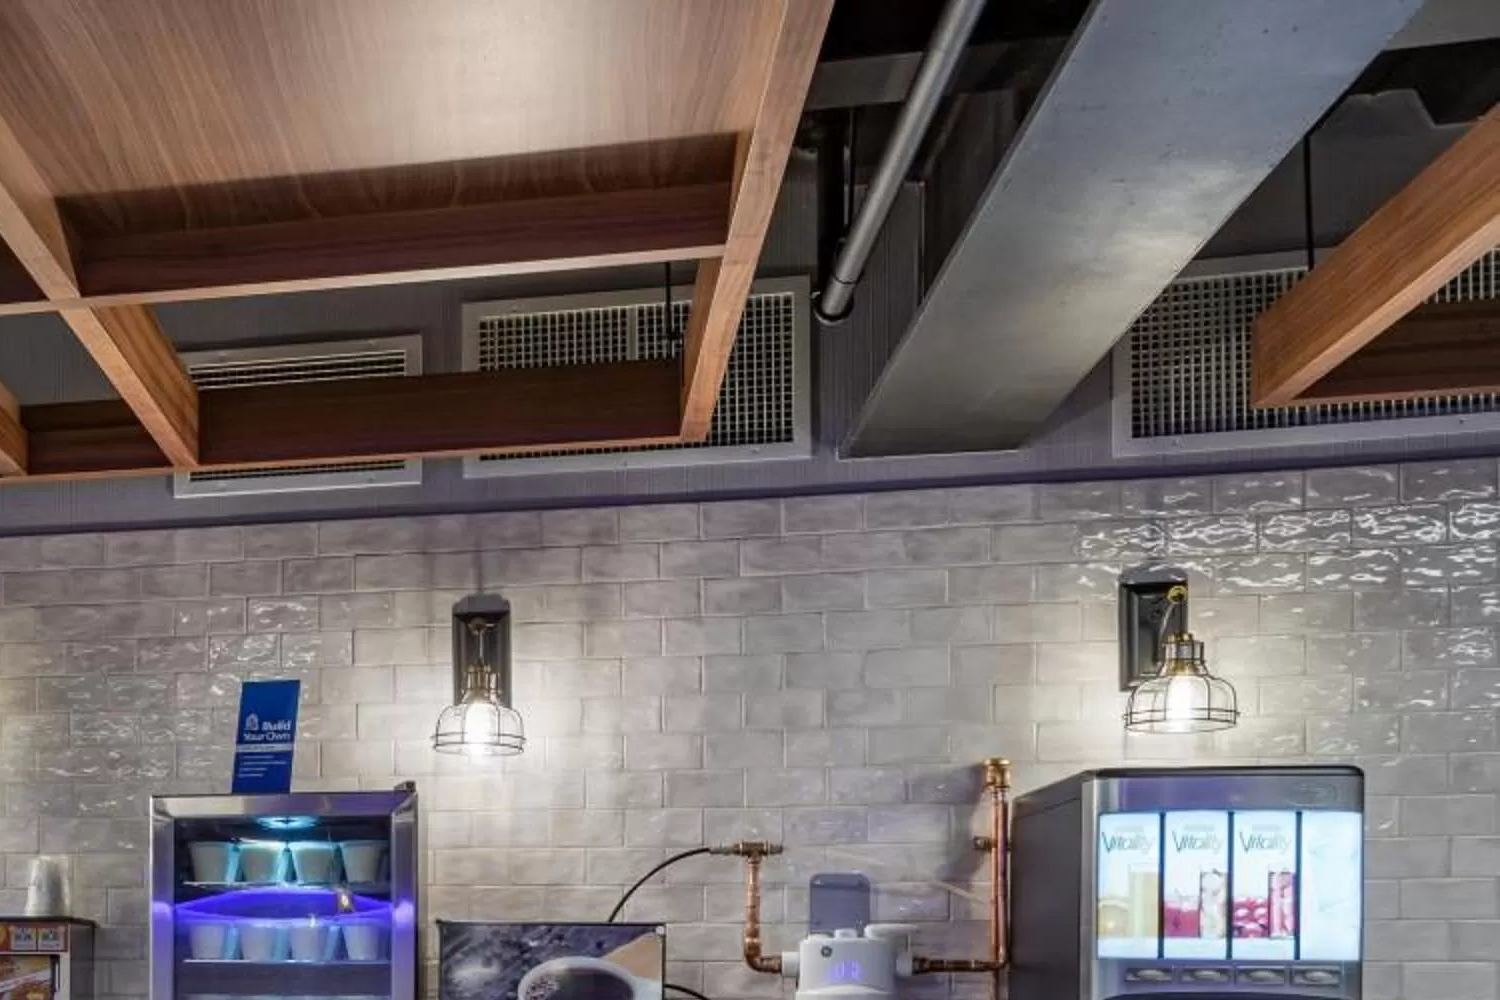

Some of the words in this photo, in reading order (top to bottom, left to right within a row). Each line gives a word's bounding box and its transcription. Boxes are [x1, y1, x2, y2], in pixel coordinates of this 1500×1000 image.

[243, 732, 265, 741] Your
[266, 731, 291, 741] Own
[262, 720, 291, 731] Build
[1101, 831, 1152, 855] Vitality
[1172, 830, 1223, 855] Vitality
[1239, 830, 1290, 855] Vitality
